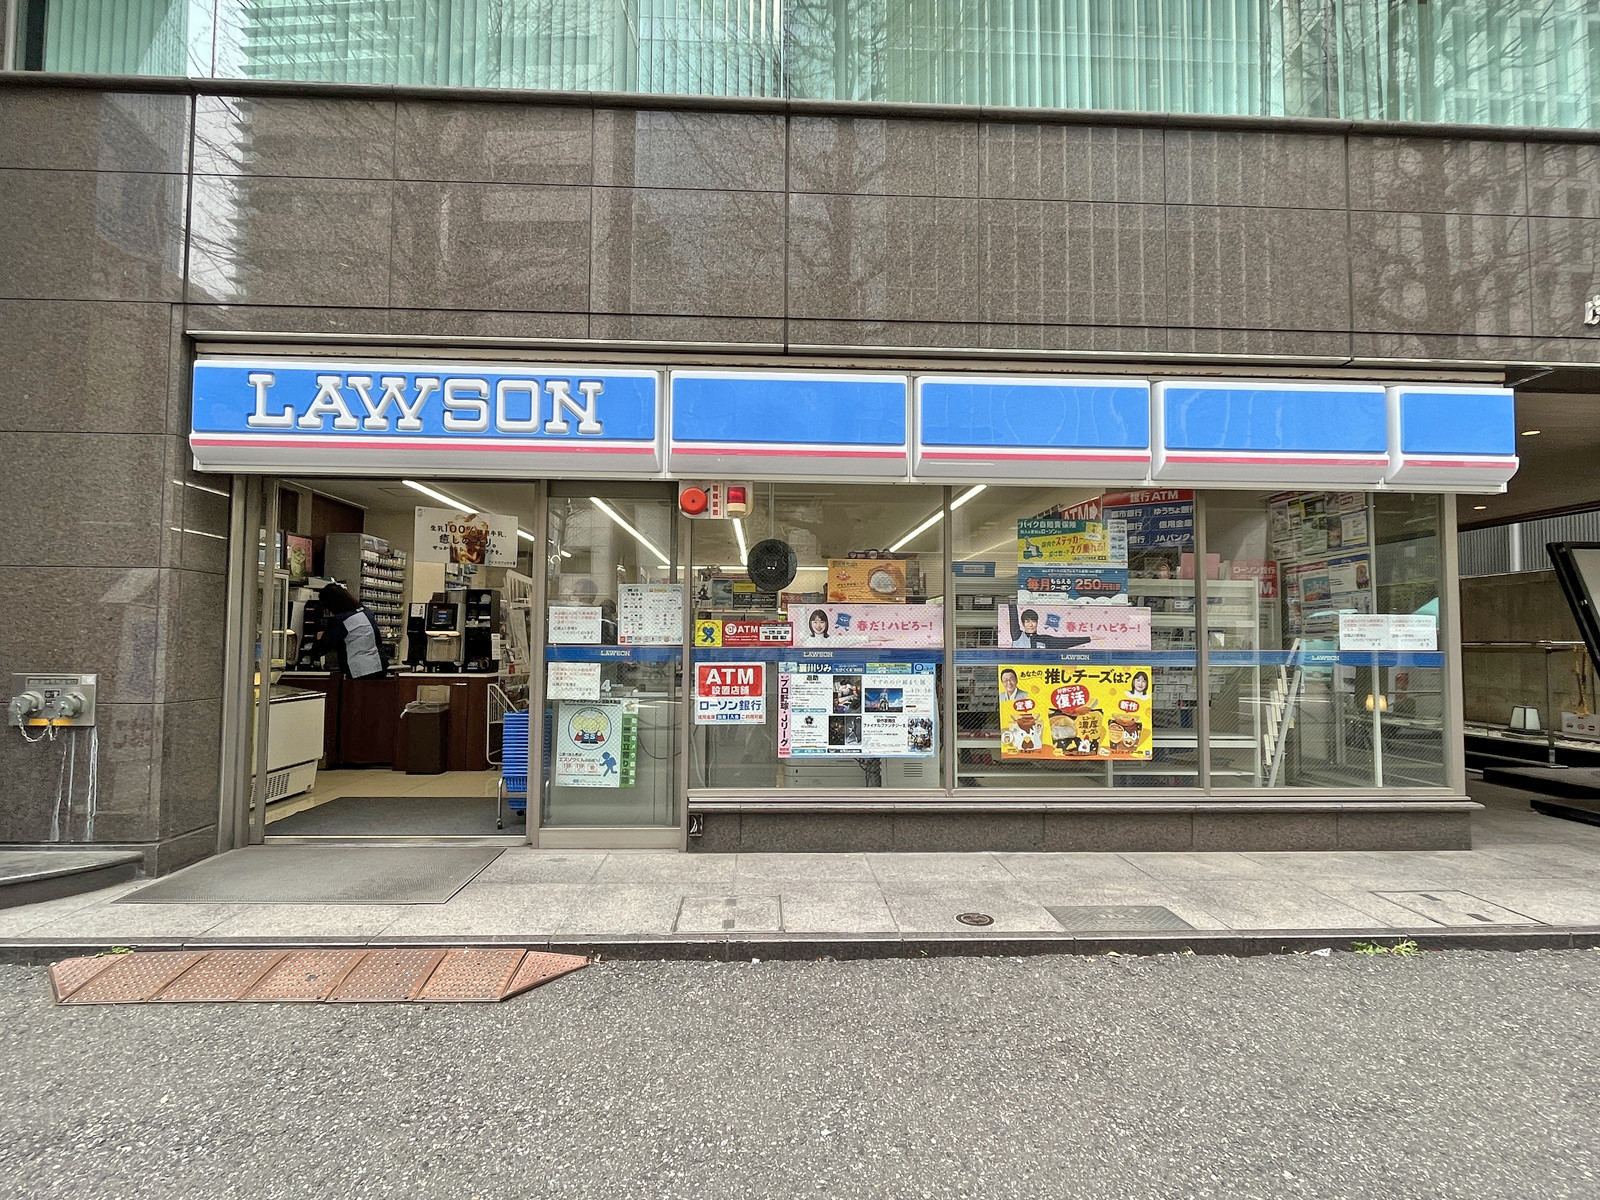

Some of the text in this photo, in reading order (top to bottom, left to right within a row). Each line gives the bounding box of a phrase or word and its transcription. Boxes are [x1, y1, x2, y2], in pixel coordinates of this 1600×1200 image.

[246, 370, 604, 434] LAWSON
[737, 625, 758, 633] ATM
[857, 620, 933, 631] 春だ!ハピろー!
[1066, 621, 1140, 633] 春だ!ハピろー!
[705, 668, 754, 685] ATM
[1020, 668, 1132, 685] あなたの 推しチーズは?
[699, 700, 762, 711] ローソン銀行
[1055, 692, 1086, 709] 復活
[1120, 701, 1138, 711] 新作
[1078, 720, 1099, 729] 濃厚
